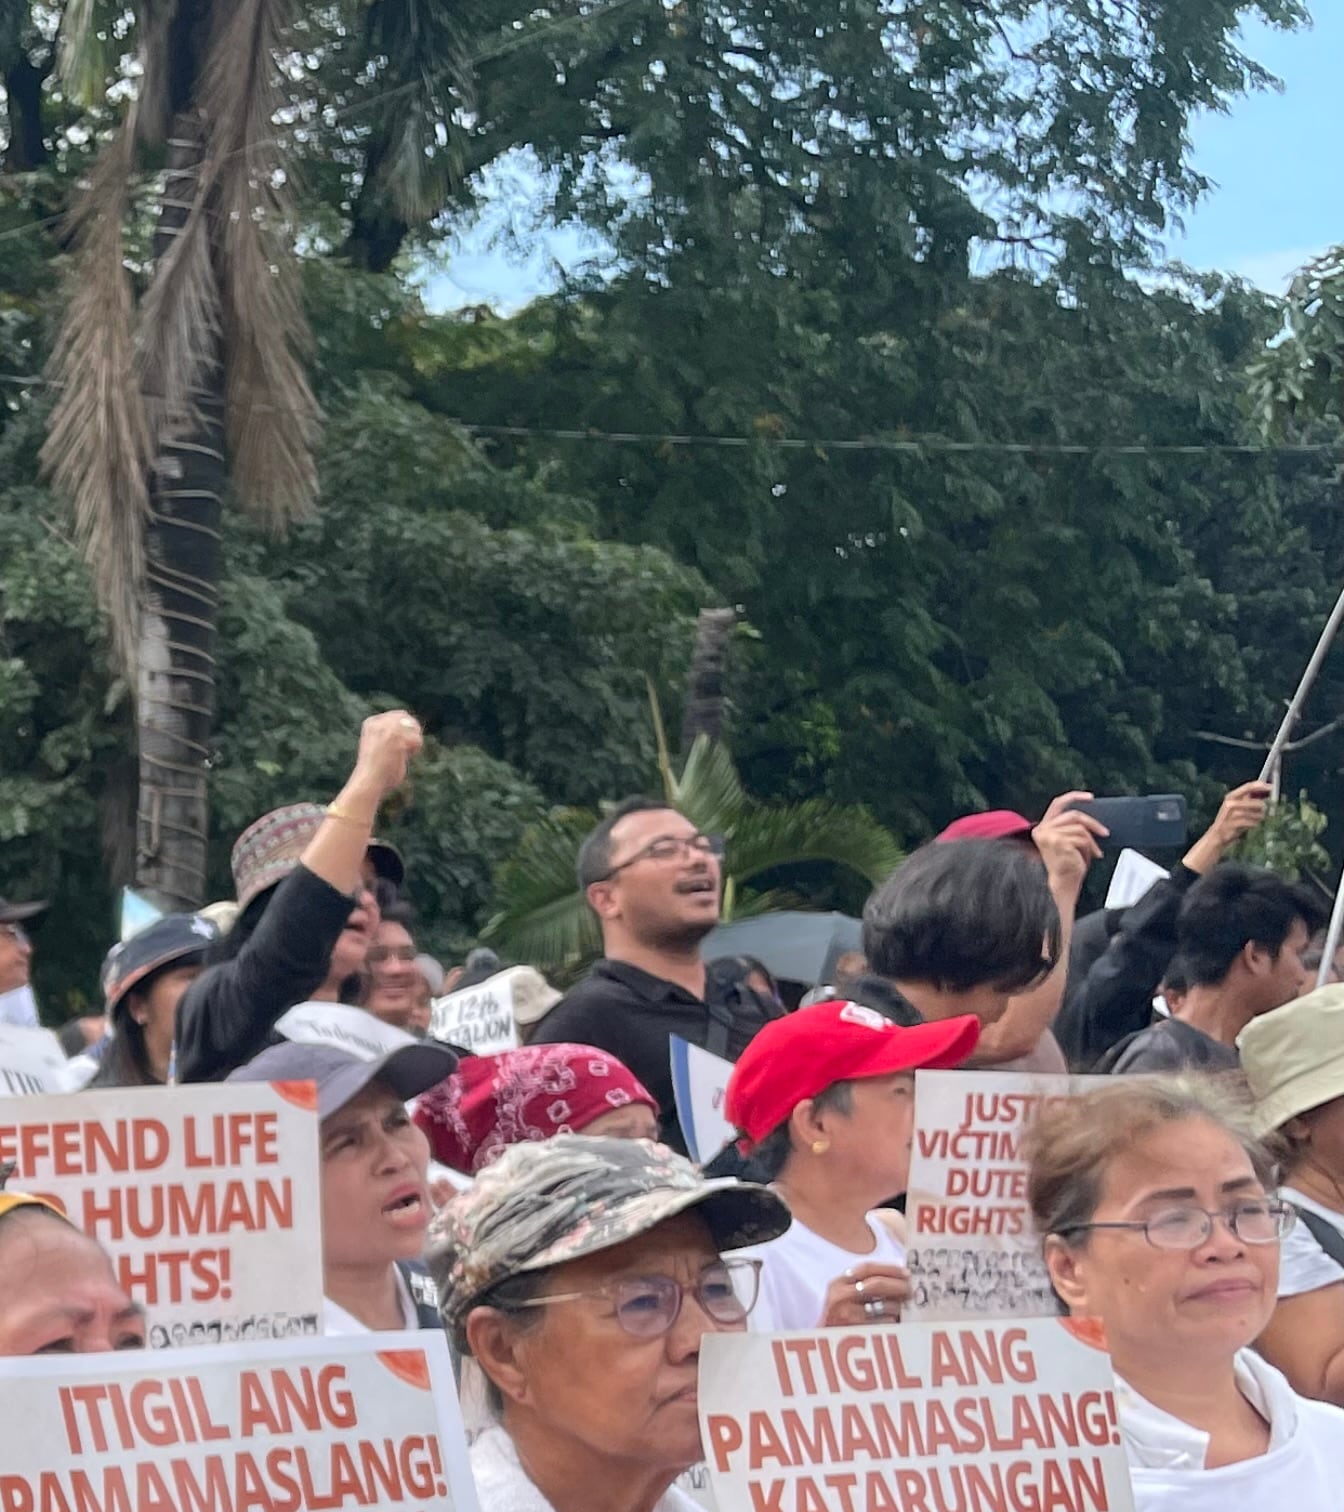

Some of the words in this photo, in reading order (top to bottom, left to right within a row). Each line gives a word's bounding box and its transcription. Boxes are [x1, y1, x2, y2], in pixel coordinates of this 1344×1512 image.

[959, 1091, 1045, 1130] JUST
[183, 1111, 279, 1168] LIFE
[916, 1128, 1026, 1161] VICTIM
[82, 1177, 293, 1241] HUMAN
[945, 1167, 1028, 1199] DUTE
[916, 1203, 1026, 1236] RIGHTS
[119, 1248, 232, 1306] HTS!
[771, 1333, 923, 1397] ITIGIL
[930, 1327, 1038, 1388] ANG
[57, 1374, 230, 1456] ITIGIL
[239, 1363, 359, 1437] ANG
[707, 1389, 1121, 1473] PAMAMASLANG!
